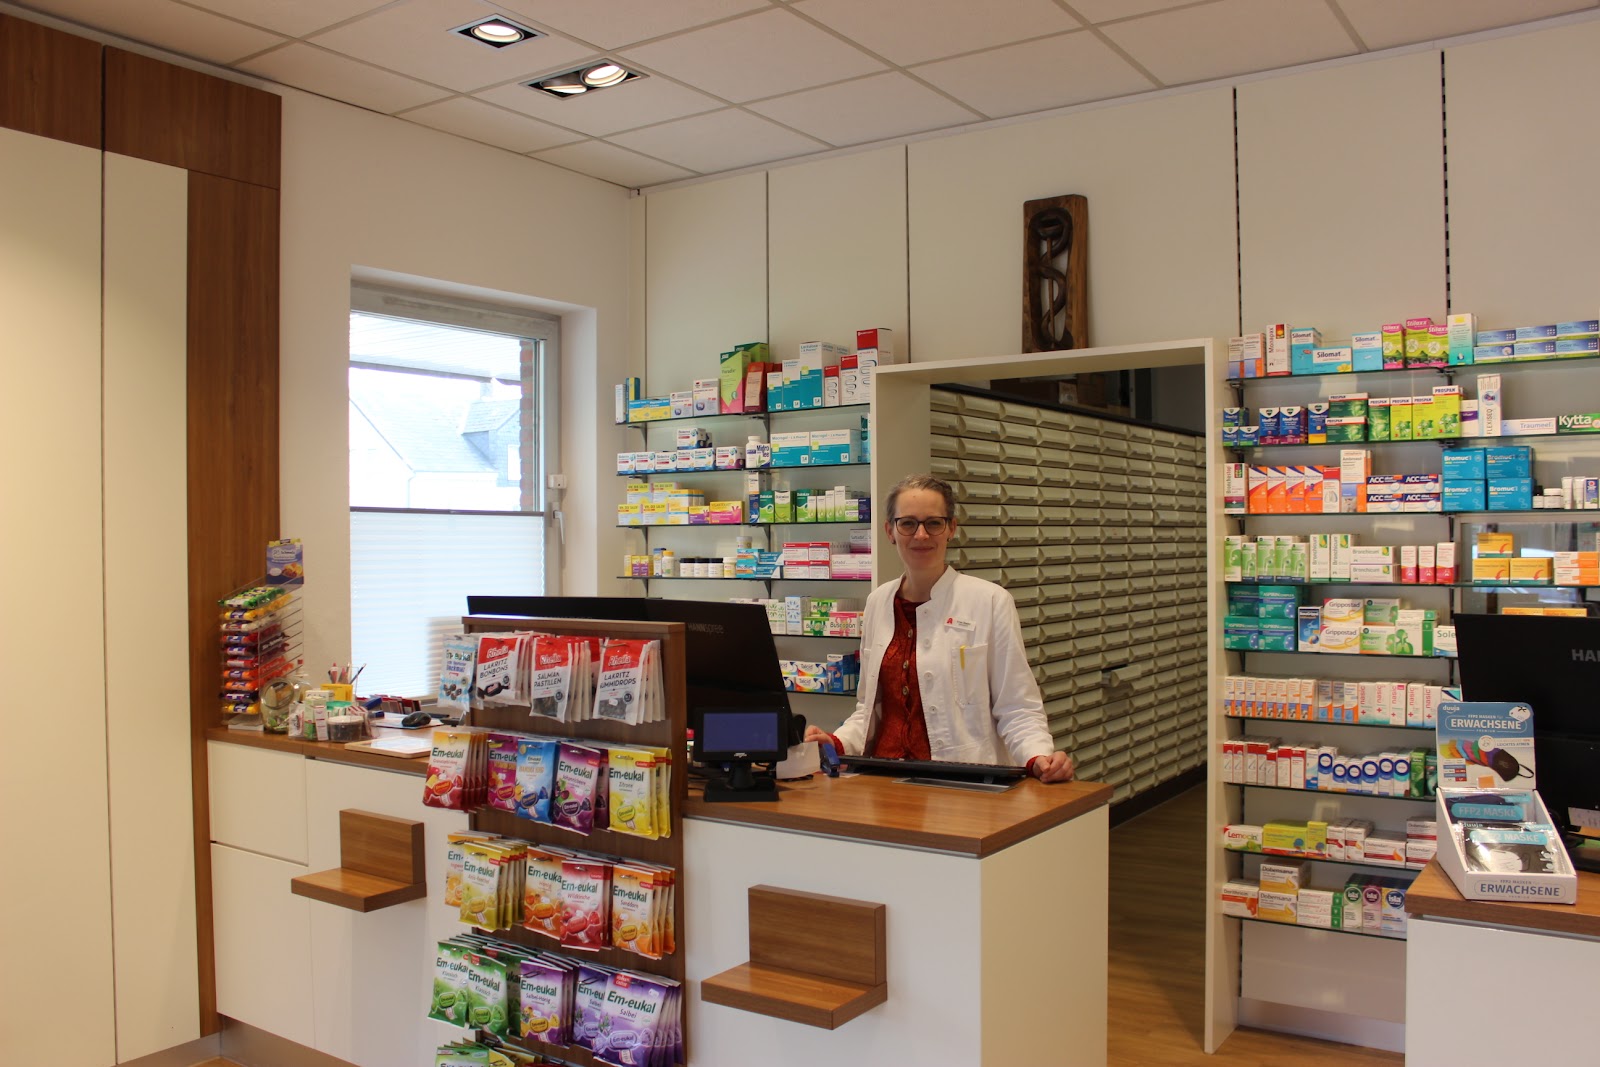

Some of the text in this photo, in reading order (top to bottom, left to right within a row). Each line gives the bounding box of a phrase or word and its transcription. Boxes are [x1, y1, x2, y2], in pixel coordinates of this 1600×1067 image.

[1558, 414, 1593, 428] Kytta
[1437, 630, 1456, 638] Sole
[1571, 649, 1600, 662] HA
[483, 658, 508, 671] LAKRITZ
[480, 665, 508, 679] BONBONS
[537, 671, 560, 680] SALMIAK
[604, 671, 630, 681] LAKRITZ
[534, 677, 562, 687] PASTILLEN
[1450, 718, 1522, 730] ERWACHSENE
[431, 747, 465, 759] Em-eukal
[489, 749, 518, 763] Em-euk
[559, 760, 593, 780] Em-eukal
[609, 767, 645, 782] Em-eukal
[1458, 806, 1517, 818] FFP2 MASKE
[1504, 833, 1540, 842] MASKE
[463, 861, 496, 878] Em-eukal
[527, 865, 563, 884] Em-euka
[560, 880, 598, 893] Em-eukal
[1480, 883, 1561, 897] ERWACHSENE
[613, 885, 648, 903] Em-eukal
[436, 957, 469, 973] Em-eukal
[468, 969, 501, 992] Em-eukal
[520, 979, 557, 997] Em-eukal
[577, 983, 605, 1000] Em-eu
[606, 990, 657, 1014] Em-eukal
[619, 1008, 638, 1019] Salbei
